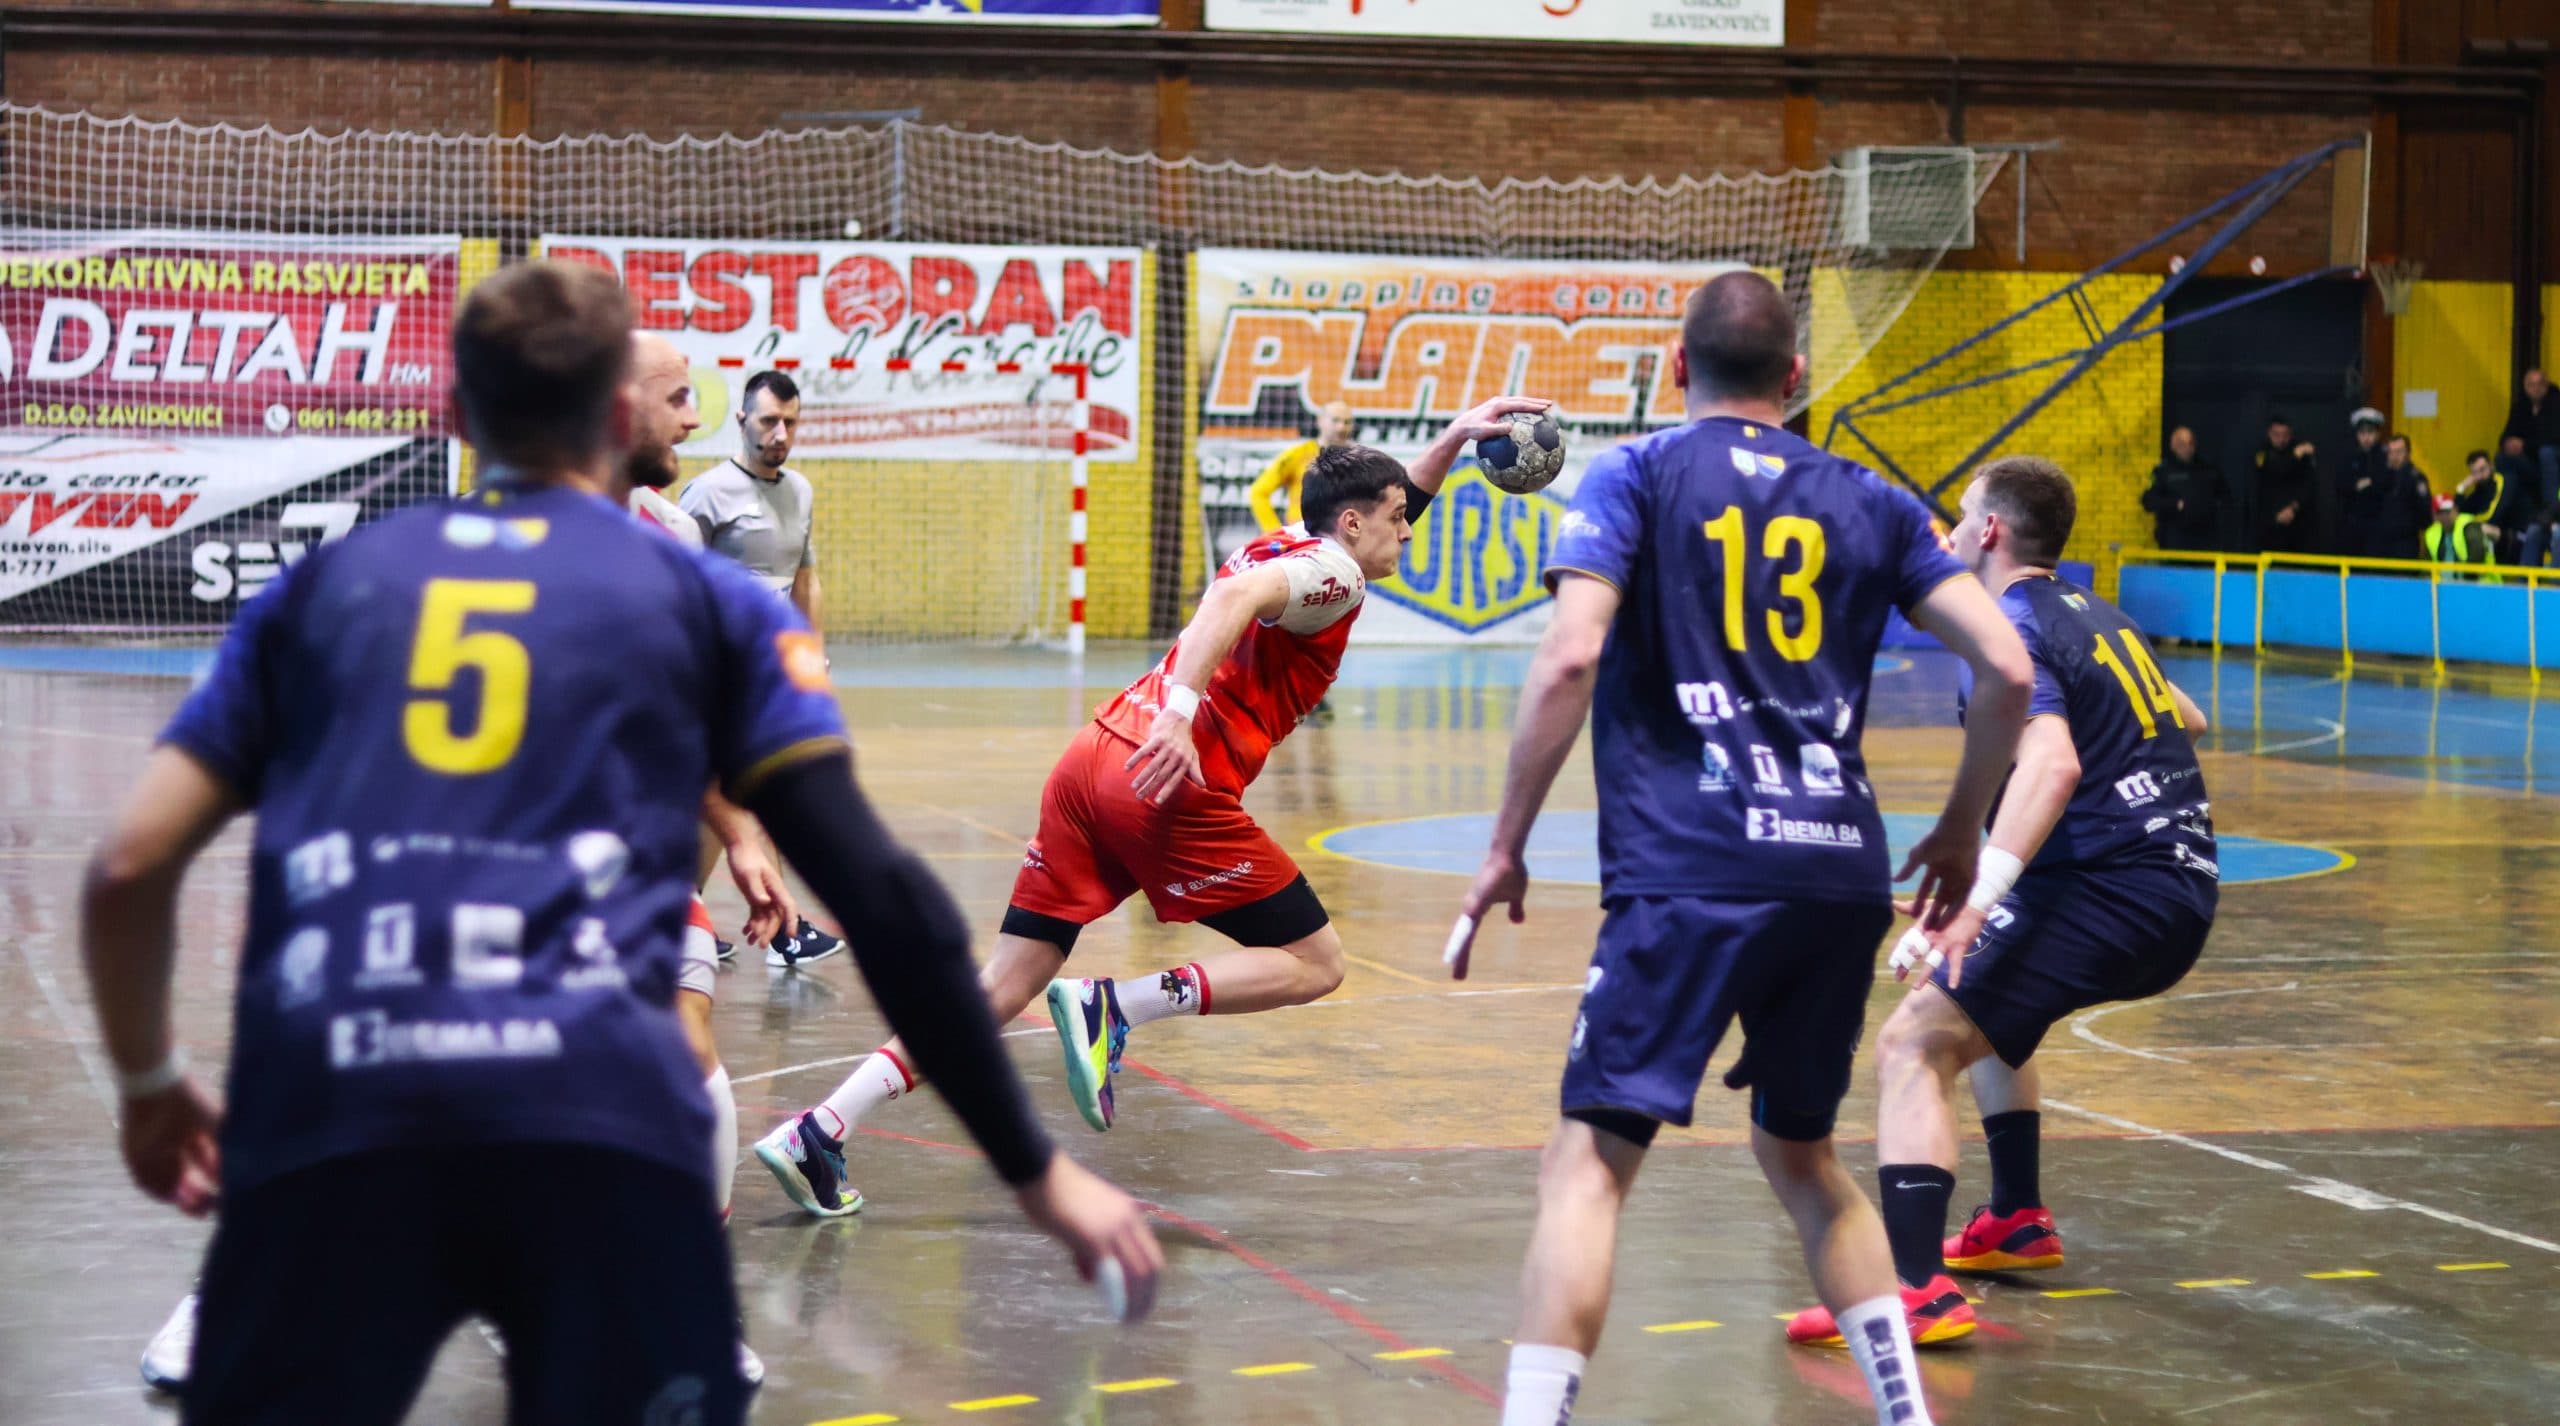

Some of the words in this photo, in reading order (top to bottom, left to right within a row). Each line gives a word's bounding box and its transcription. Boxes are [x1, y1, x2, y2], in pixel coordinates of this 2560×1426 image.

[253, 261, 431, 295] RASVJETA
[1237, 276, 1493, 312] shopping
[1554, 283, 1690, 311] cent
[27, 297, 398, 386] DELTAH
[0, 470, 48, 487] to
[1703, 505, 1827, 663] 13
[403, 577, 538, 776] 5
[2091, 628, 2185, 740] 14
[1782, 818, 1836, 841] BEMA
